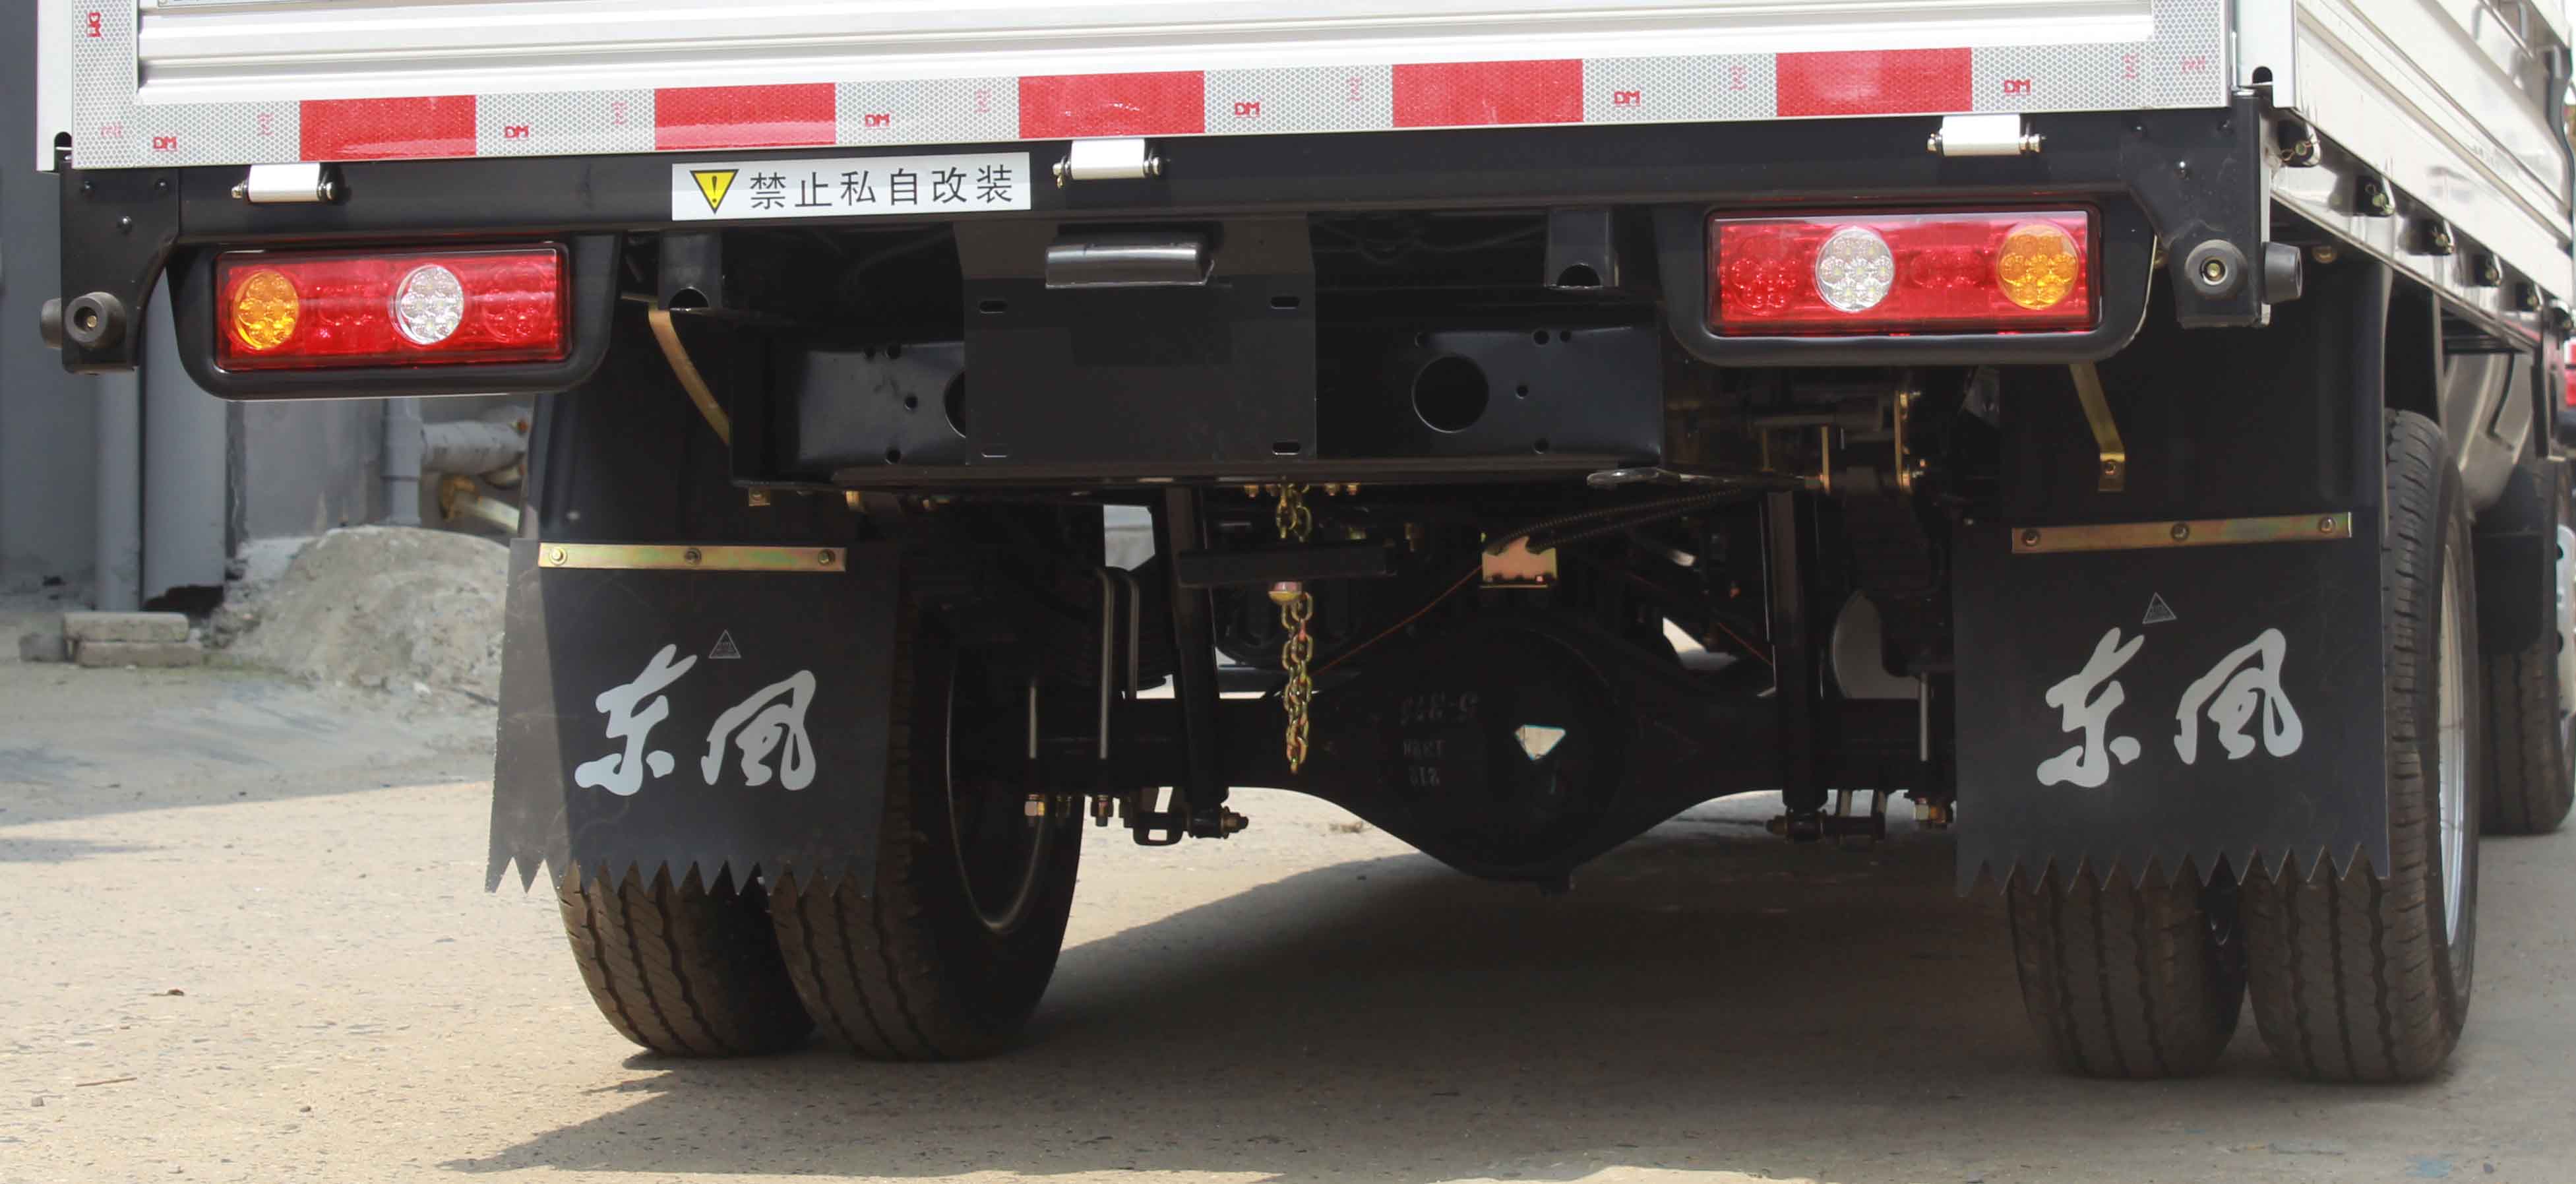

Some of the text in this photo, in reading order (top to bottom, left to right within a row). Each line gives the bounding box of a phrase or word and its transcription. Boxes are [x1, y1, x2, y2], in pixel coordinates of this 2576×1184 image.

[88, 11, 101, 38] DM
[2004, 79, 2031, 94] DM
[1614, 90, 1641, 105] DM
[1234, 102, 1260, 117] DM
[865, 113, 890, 127] DM
[505, 126, 529, 138] DM
[153, 137, 177, 149] DM
[749, 164, 1013, 209] 禁止私自改装
[2037, 627, 2304, 788] 东风
[574, 643, 816, 796] 东风
